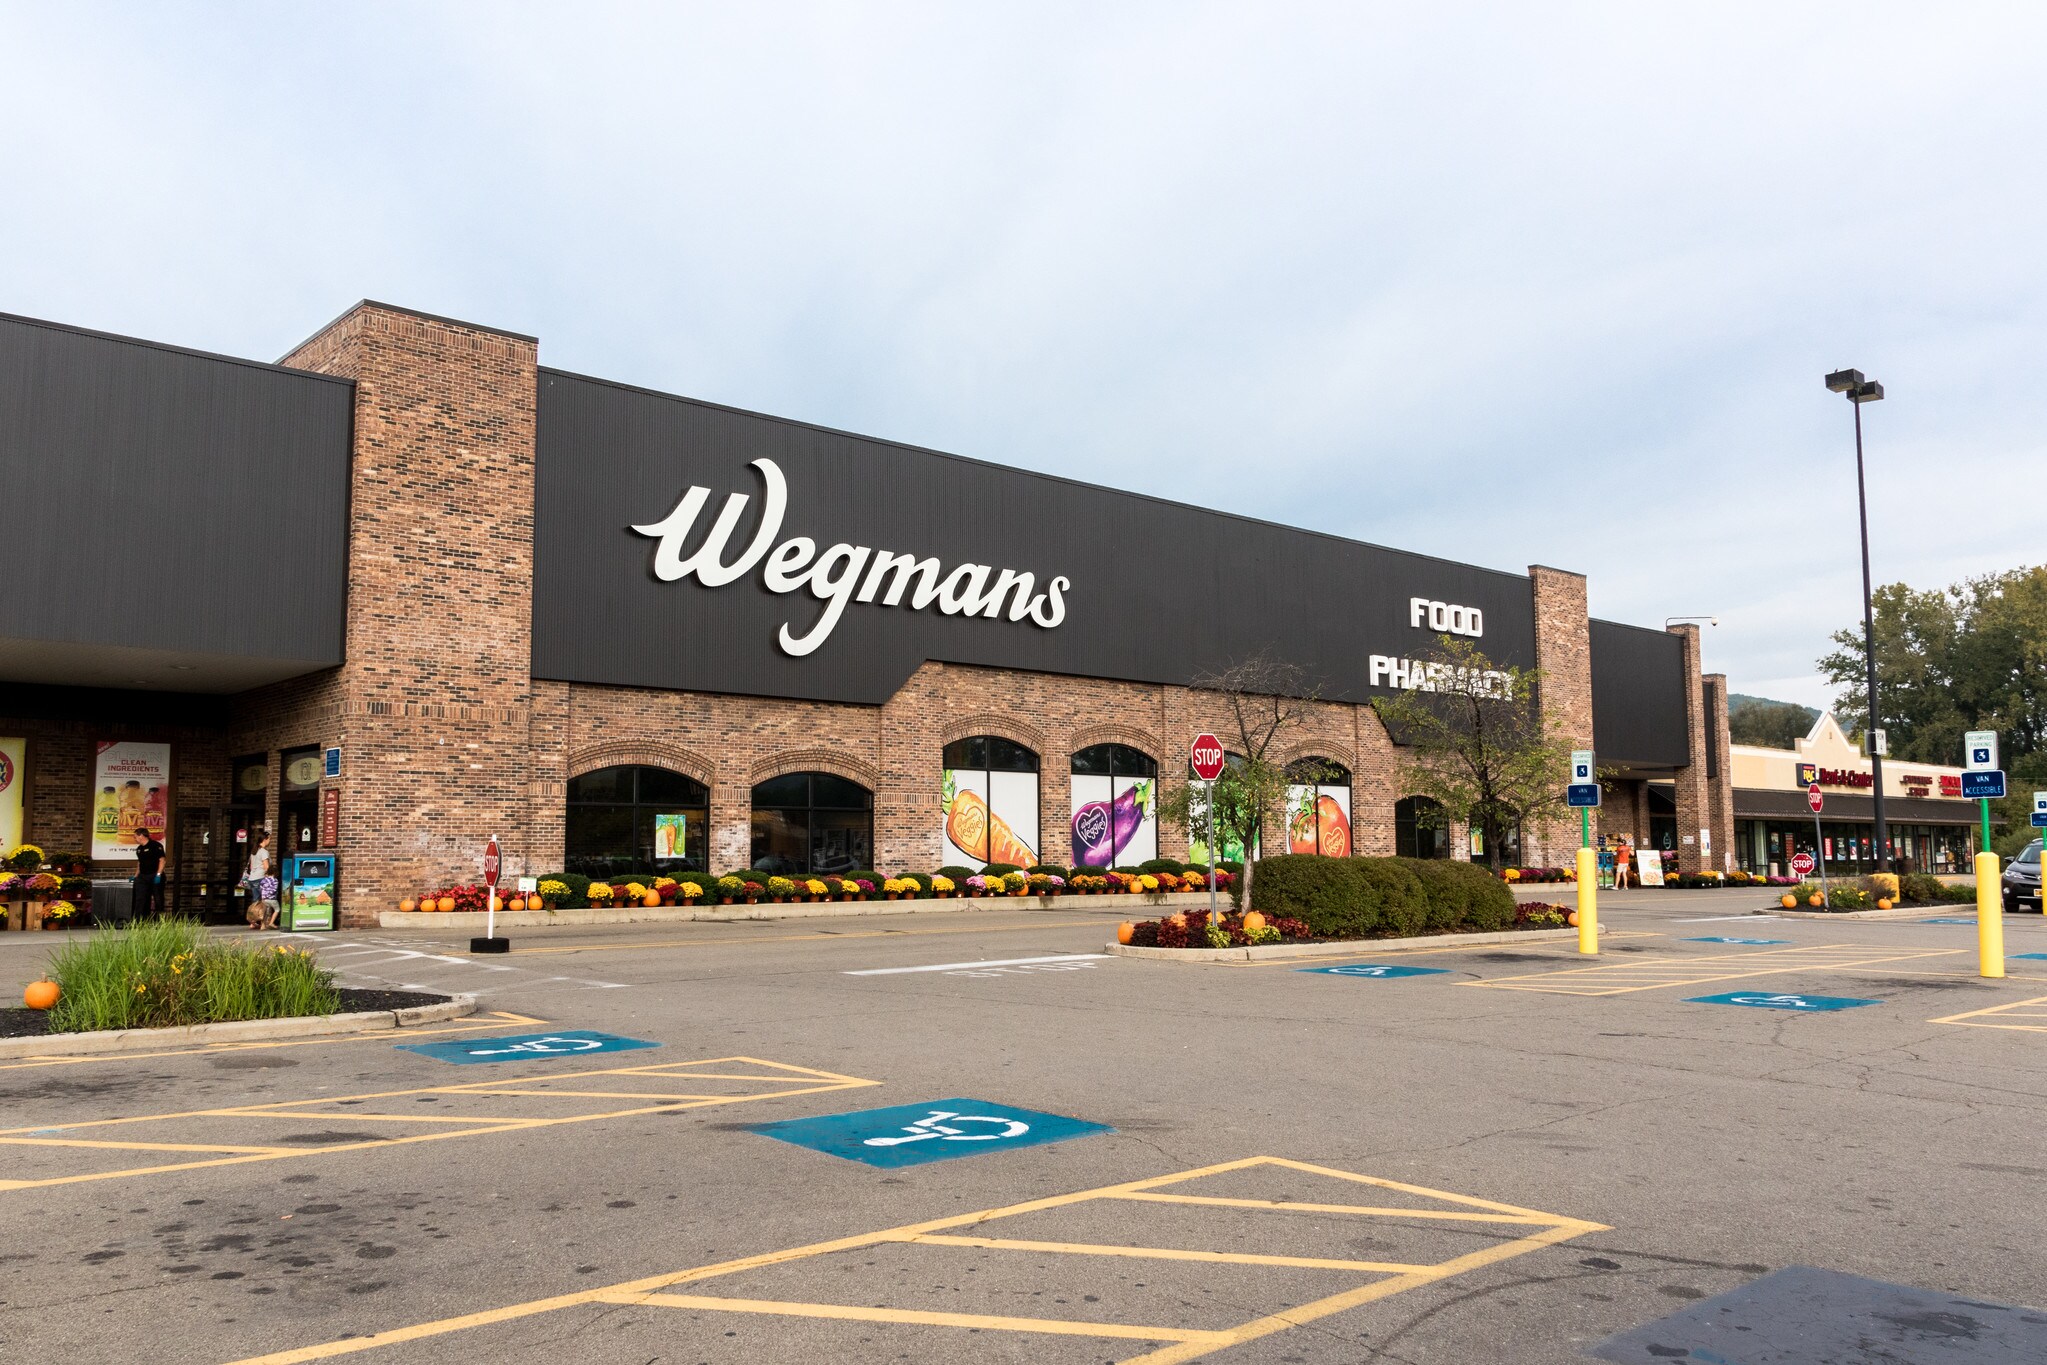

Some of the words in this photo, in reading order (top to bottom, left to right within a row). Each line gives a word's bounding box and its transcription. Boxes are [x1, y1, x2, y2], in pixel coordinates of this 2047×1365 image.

[630, 457, 1071, 657] Wegmans
[1410, 597, 1483, 638] FOOD
[1195, 748, 1221, 766] STOP
[1809, 792, 1822, 804] STOP
[1965, 785, 2002, 795] ACCESSIBLE
[1081, 816, 1106, 841] Veggies
[485, 855, 498, 873] STOP
[1793, 859, 1812, 869] STOP
